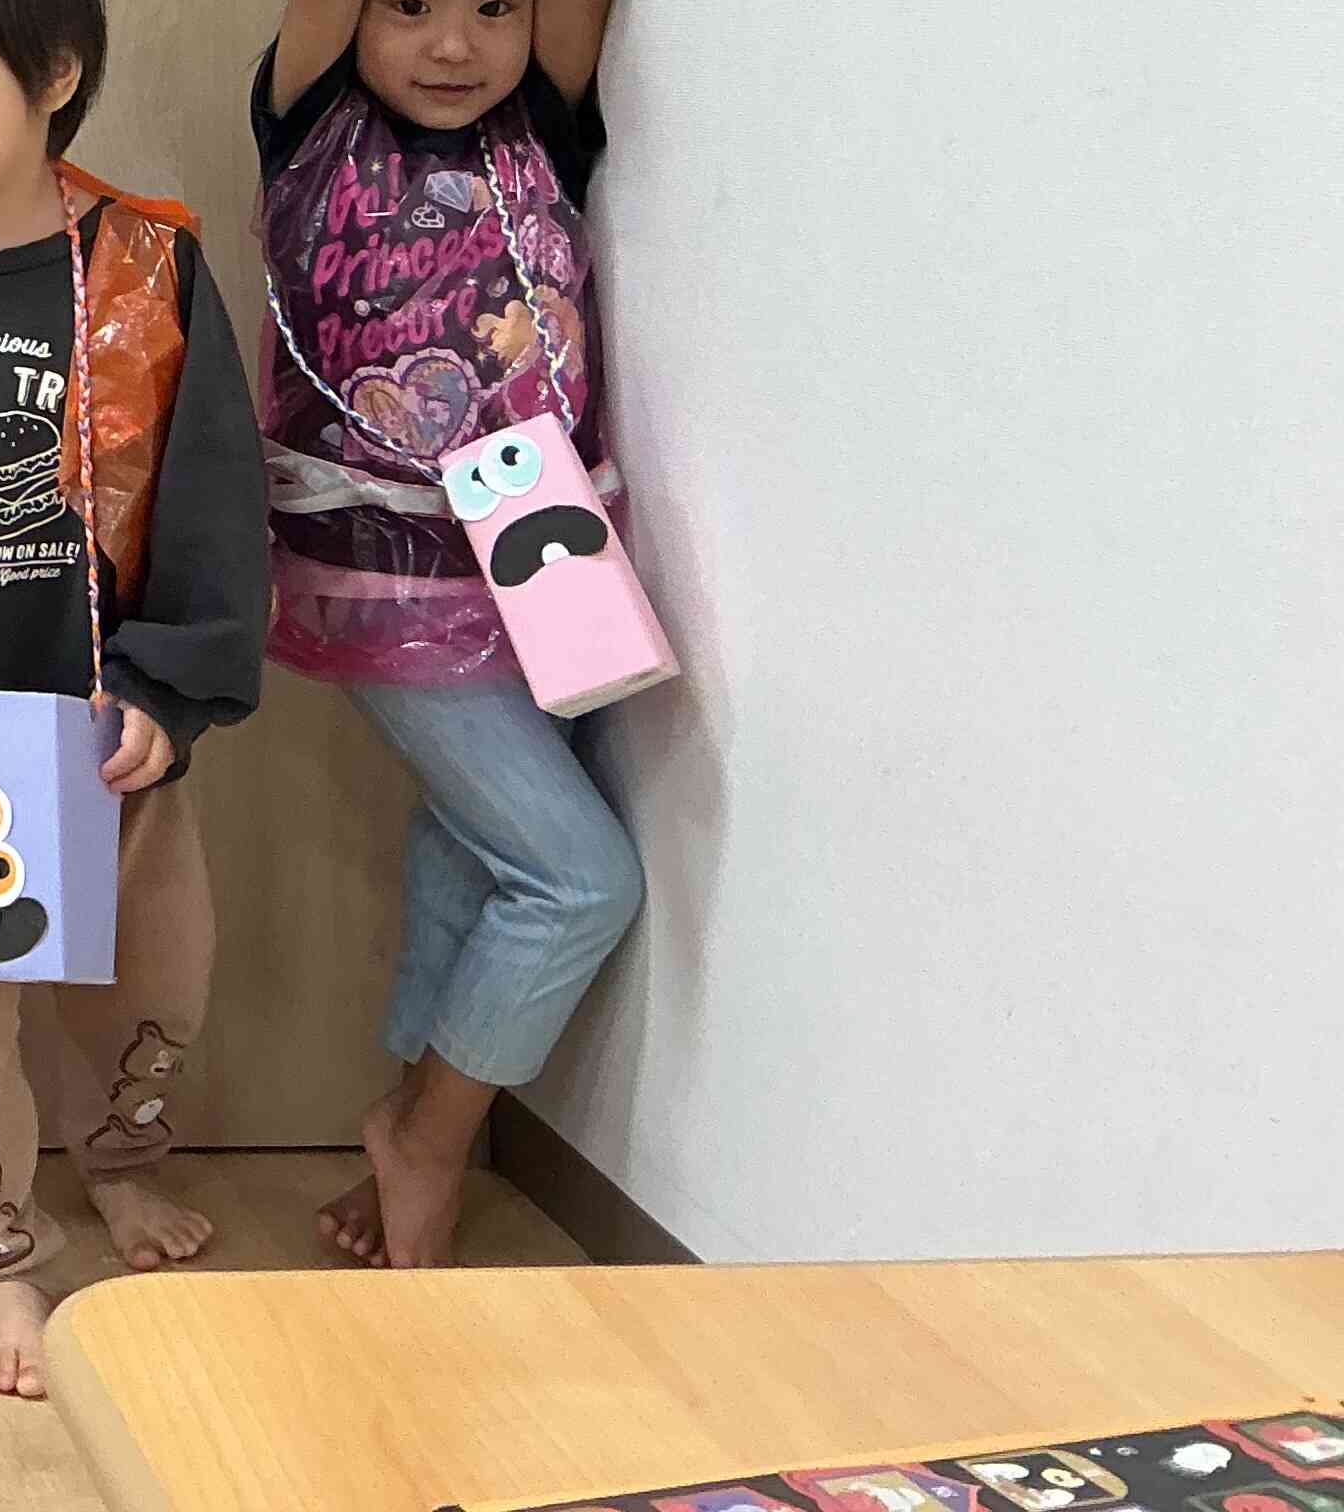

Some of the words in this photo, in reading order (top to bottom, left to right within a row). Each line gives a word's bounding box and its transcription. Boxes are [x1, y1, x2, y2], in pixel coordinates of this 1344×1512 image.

[13, 366, 67, 413] TR
[16, 543, 36, 559] ON
[38, 541, 81, 558] SALE!
